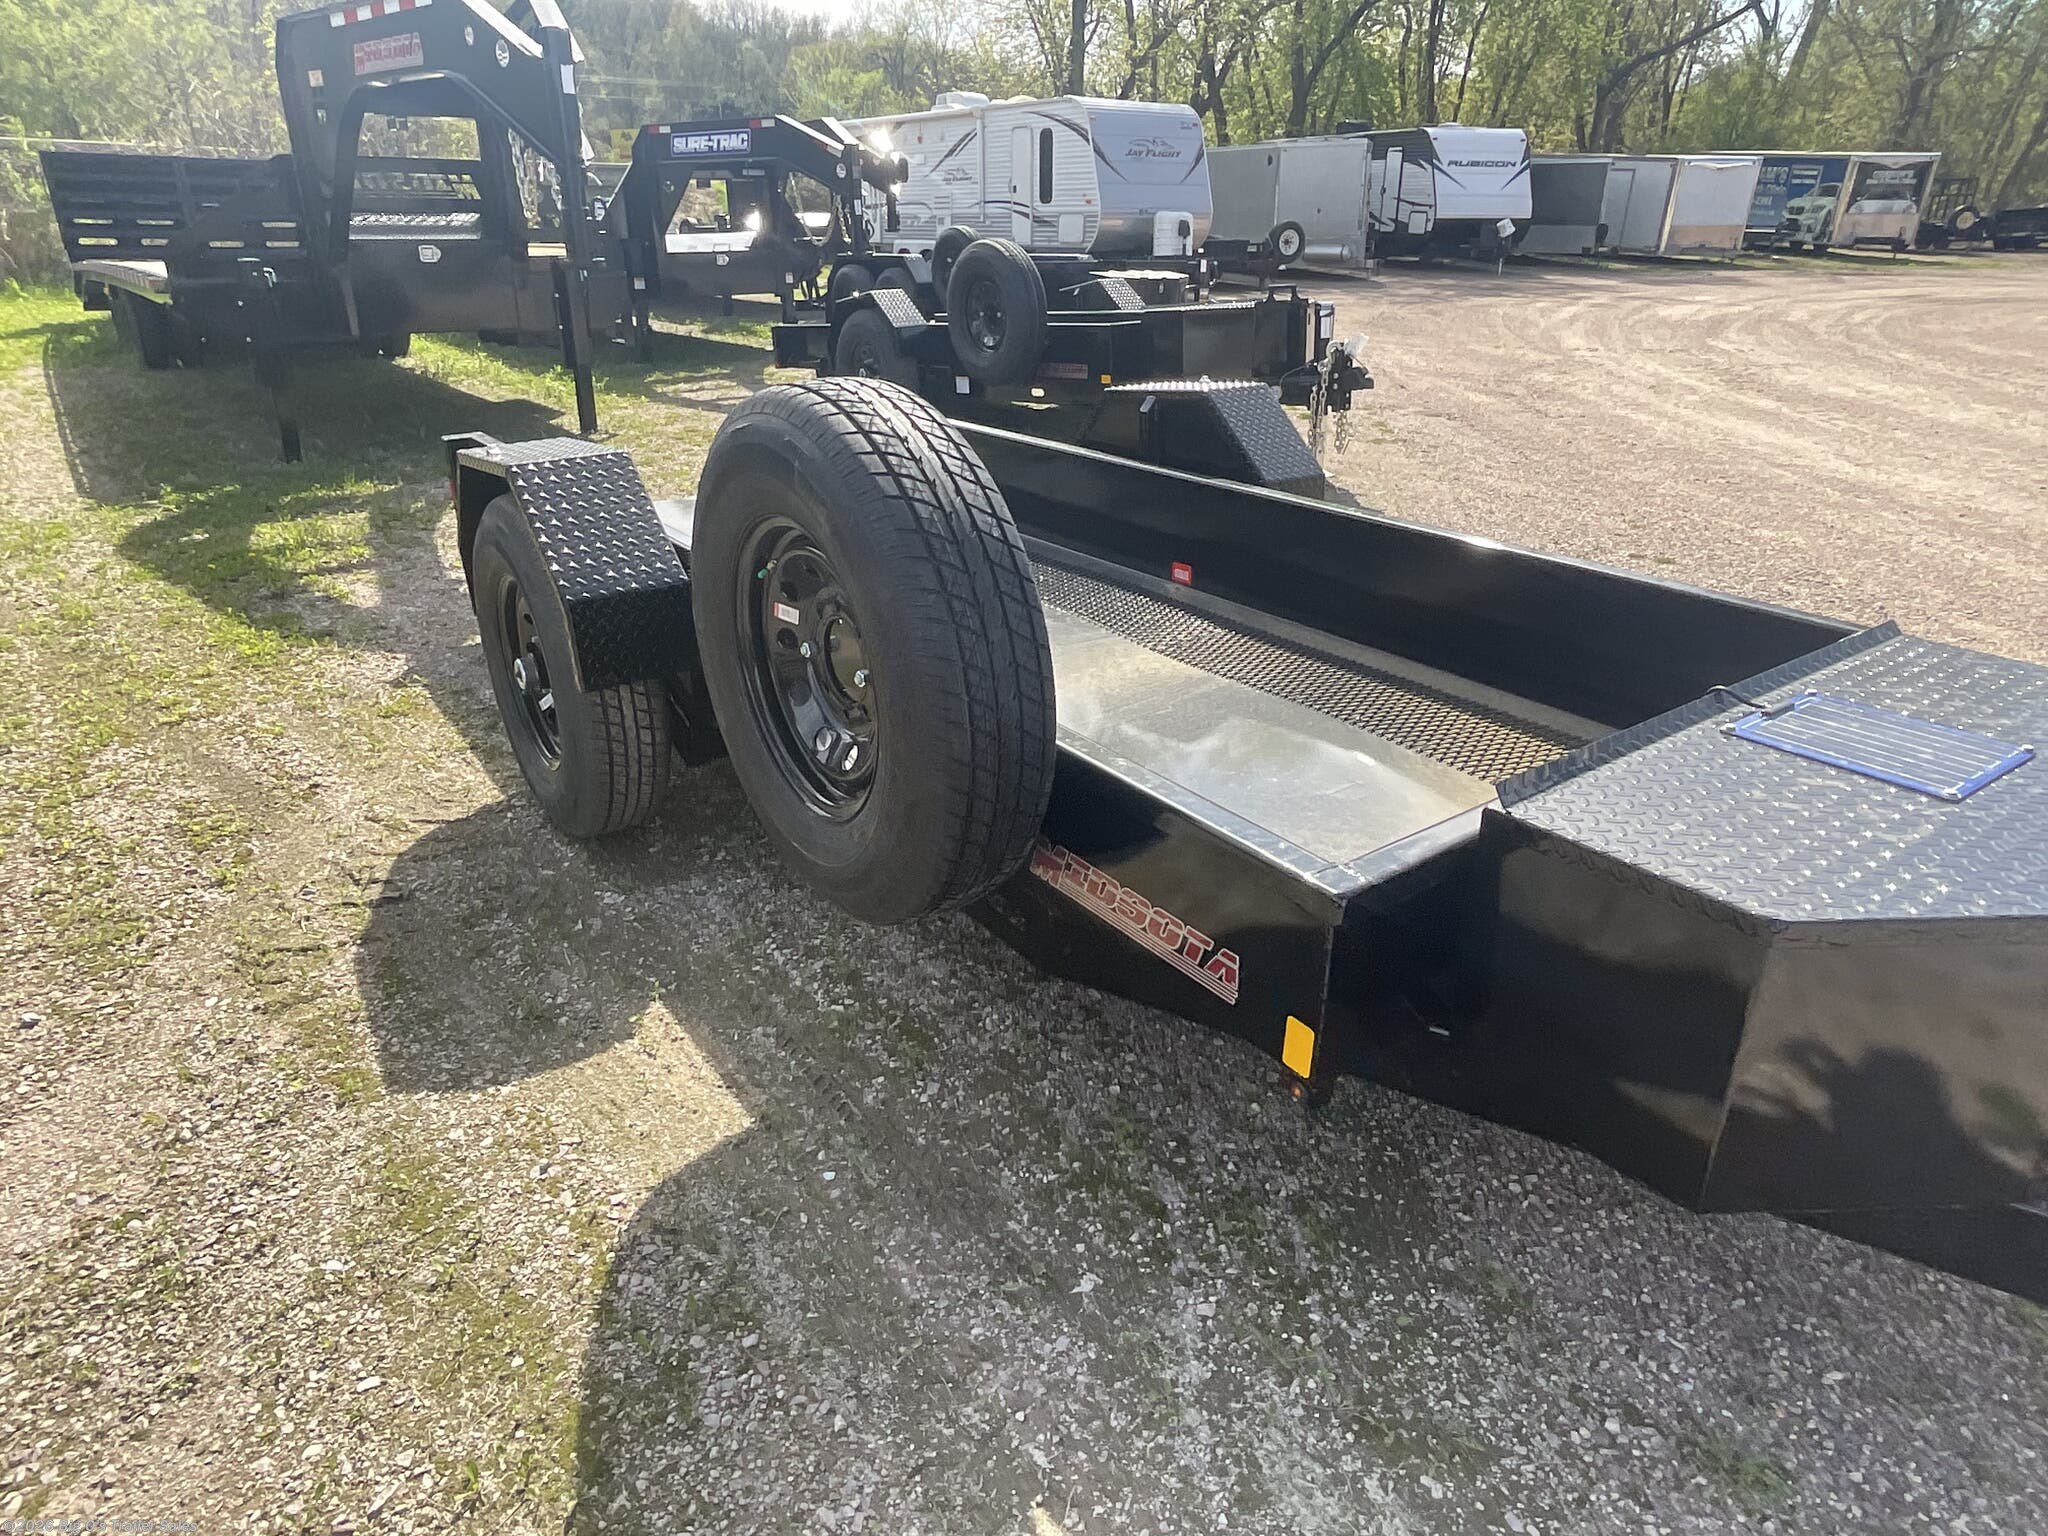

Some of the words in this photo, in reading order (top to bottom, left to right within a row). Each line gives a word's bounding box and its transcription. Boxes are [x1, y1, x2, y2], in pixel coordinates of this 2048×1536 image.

[673, 133, 748, 153] SURE-TRAC
[1447, 160, 1517, 168] RUBICON
[1030, 838, 1240, 991] MIDSOTA
